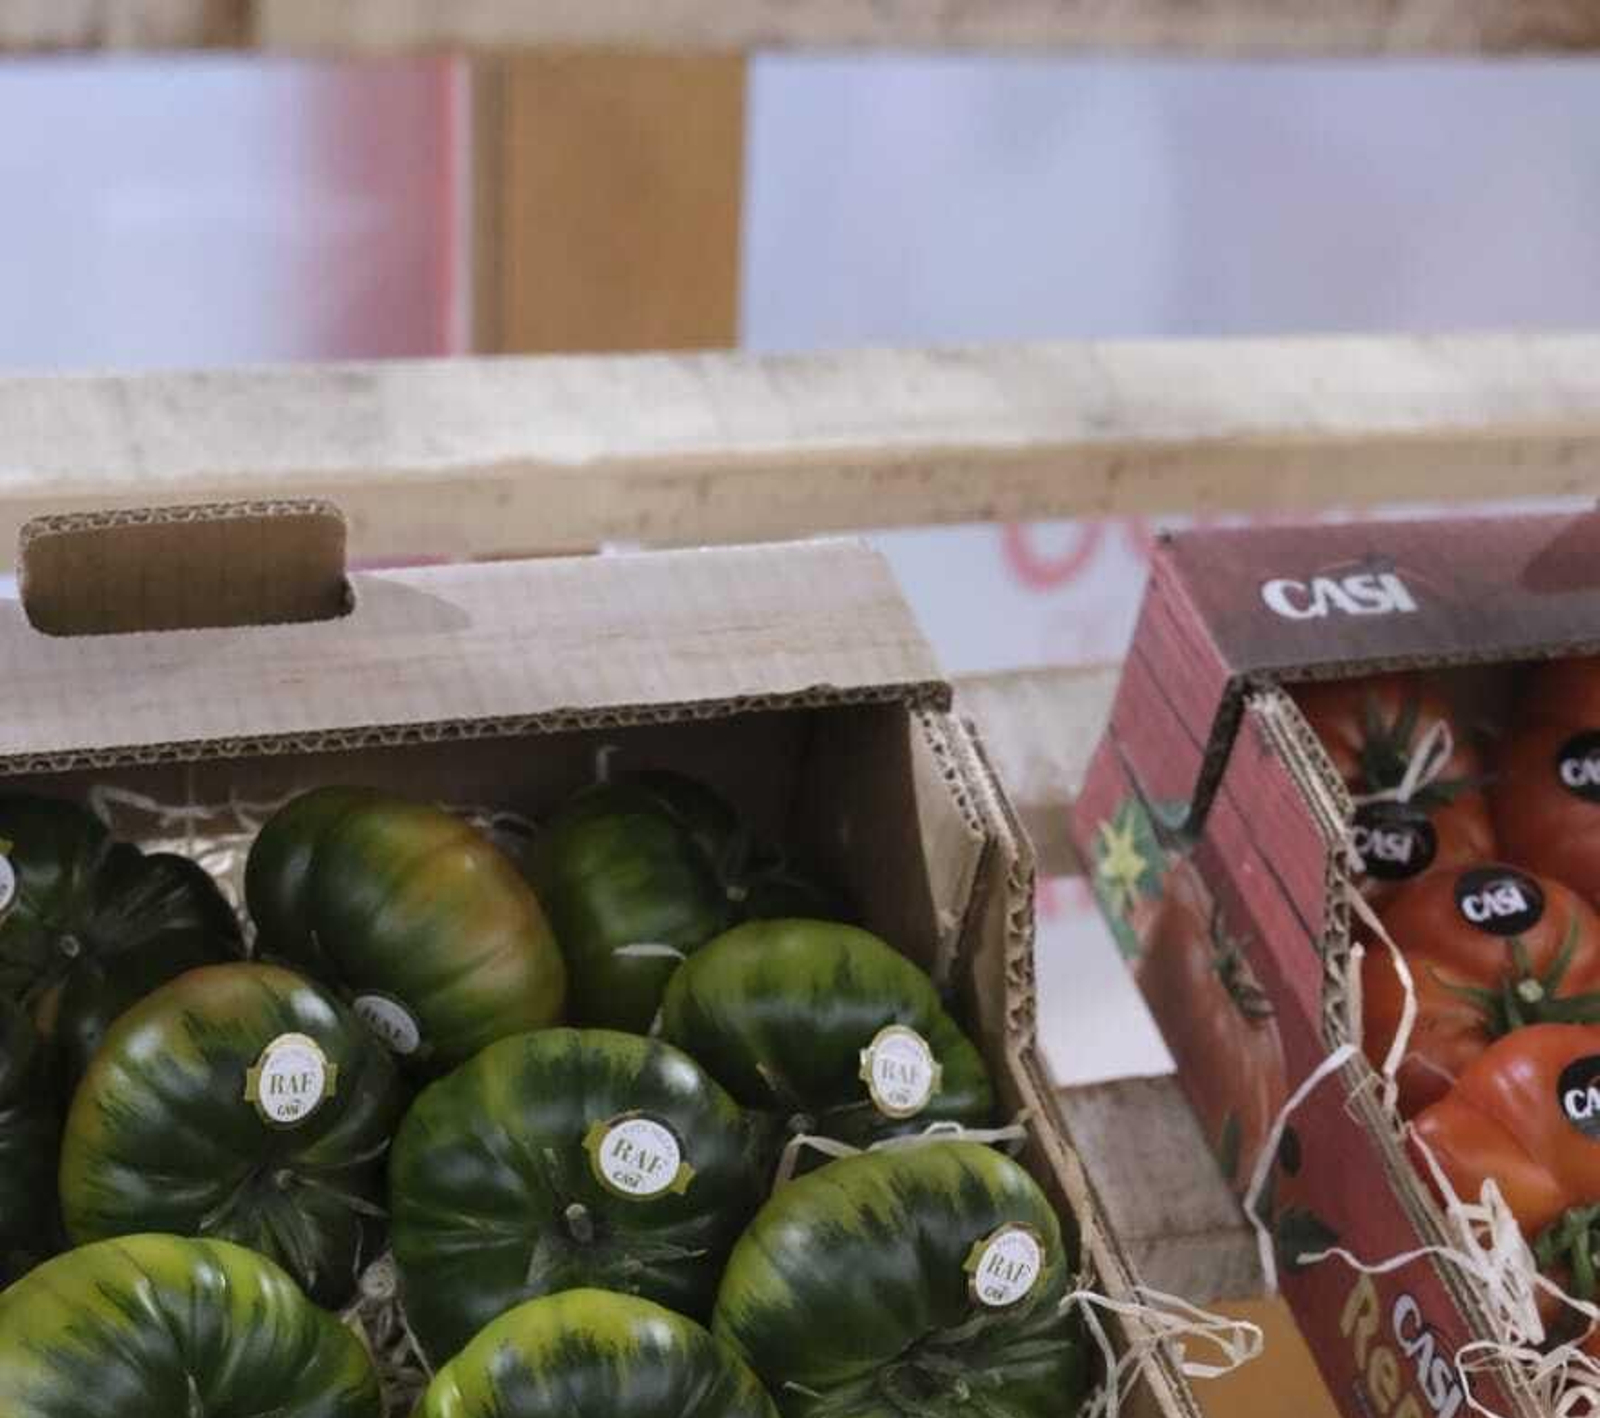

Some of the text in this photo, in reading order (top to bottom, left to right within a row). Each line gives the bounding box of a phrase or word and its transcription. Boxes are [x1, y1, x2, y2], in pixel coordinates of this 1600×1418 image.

[1261, 573, 1417, 619] CASI
[1561, 757, 1600, 786] CA
[1351, 825, 1412, 863] CASI
[1461, 885, 1529, 922] CASI
[268, 1072, 315, 1095] RAF
[882, 1058, 921, 1084] RAF
[1564, 1087, 1600, 1119] CA
[610, 1138, 665, 1175] RAF
[986, 1252, 1033, 1284] RAF
